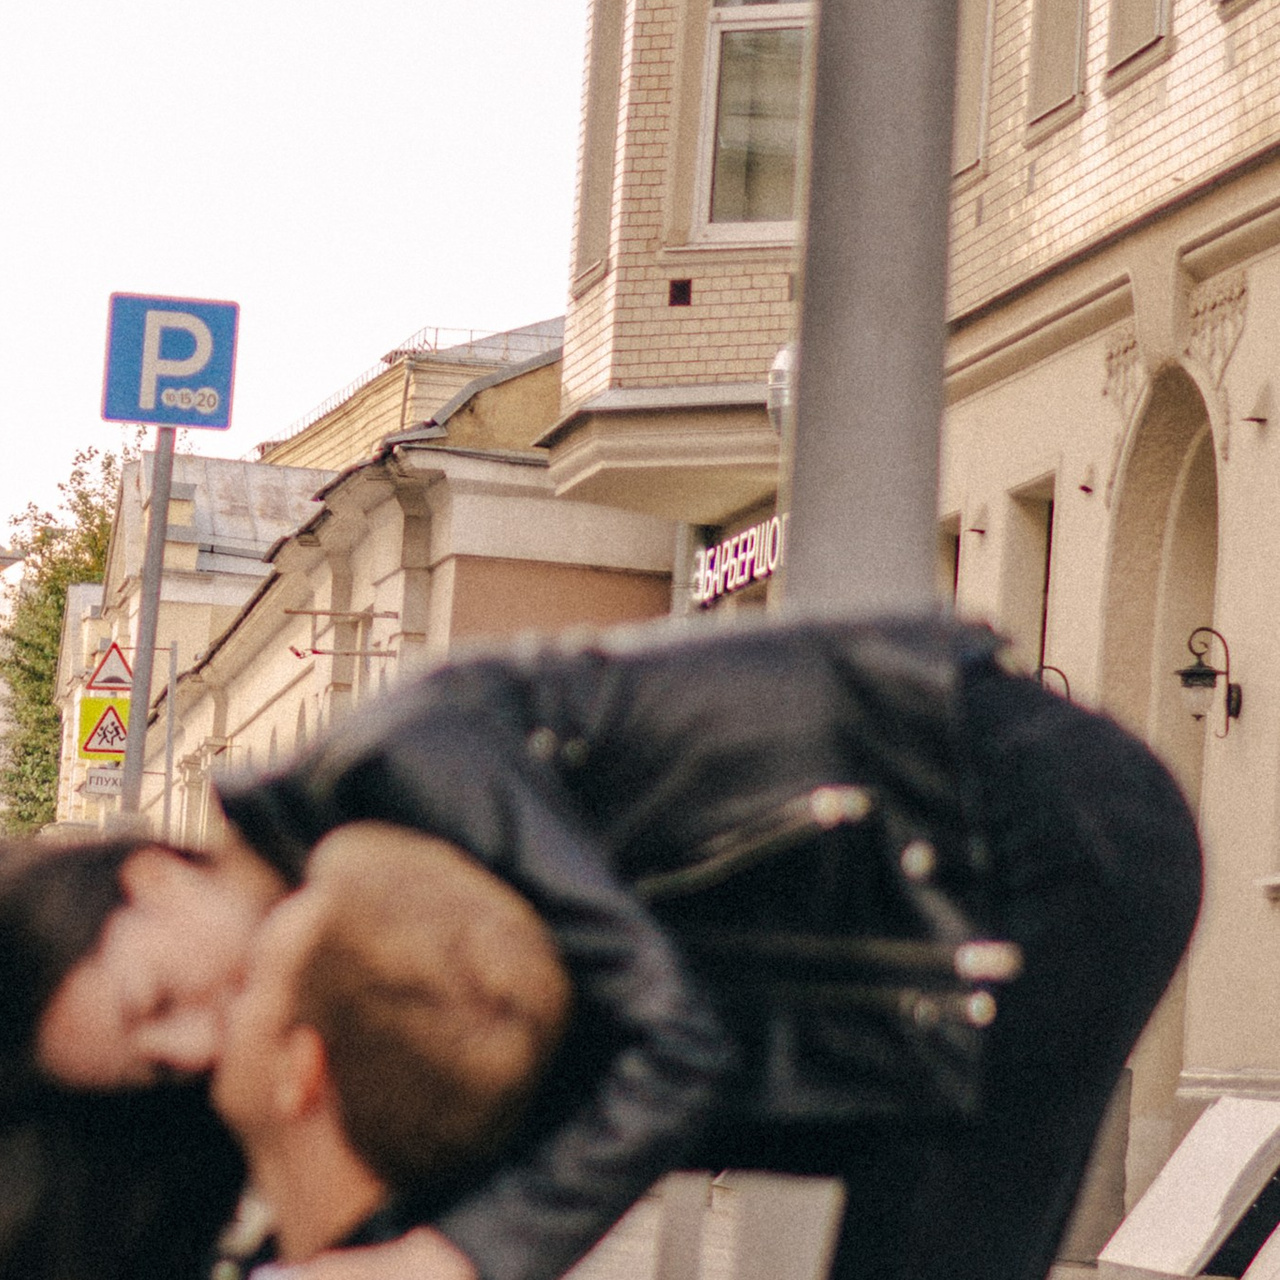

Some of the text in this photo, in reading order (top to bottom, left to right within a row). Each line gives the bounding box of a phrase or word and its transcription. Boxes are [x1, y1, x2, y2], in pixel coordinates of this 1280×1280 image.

[139, 310, 213, 409] P
[181, 391, 192, 404] 15
[195, 392, 217, 408] 20
[89, 775, 122, 787] ГЛУХ
